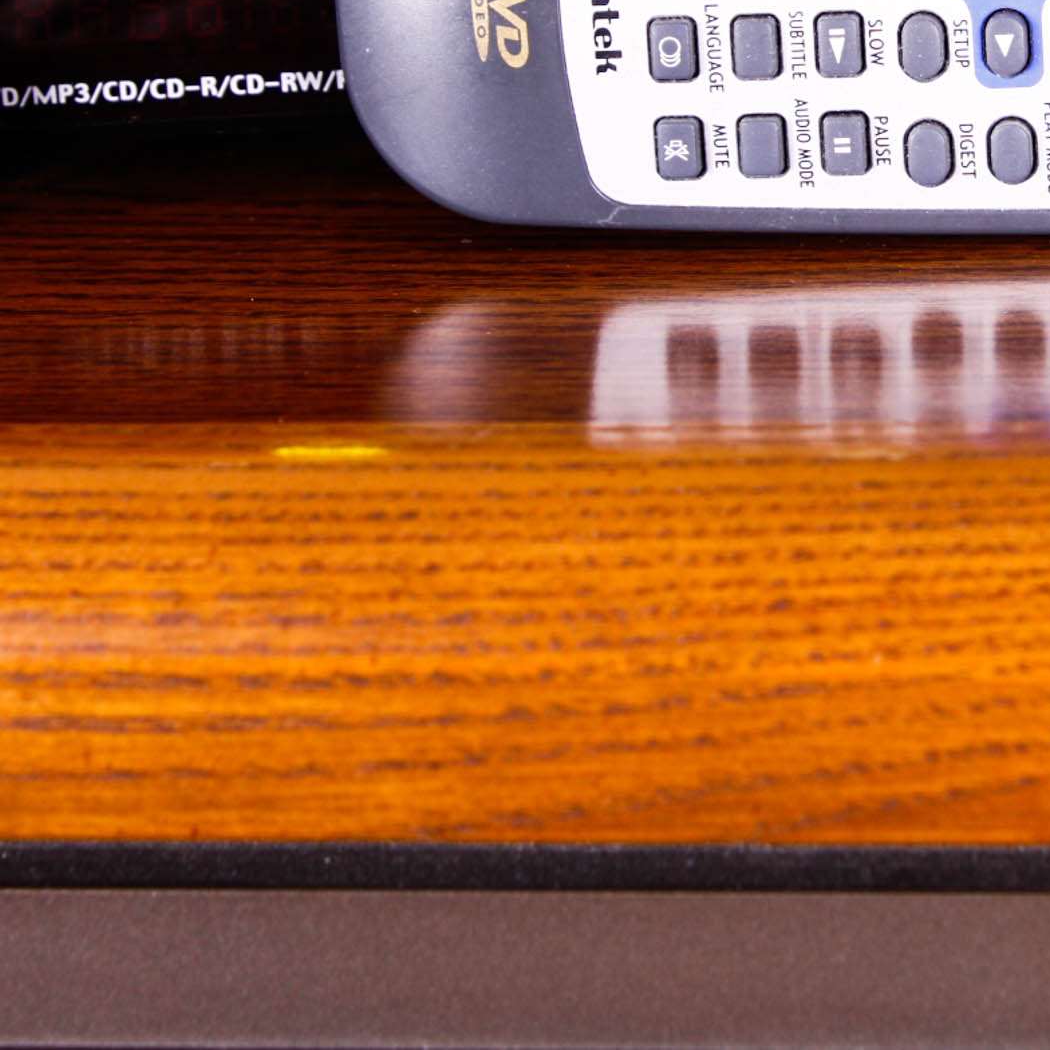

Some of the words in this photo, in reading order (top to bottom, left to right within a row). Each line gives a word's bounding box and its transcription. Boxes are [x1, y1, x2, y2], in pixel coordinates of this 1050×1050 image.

[704, 5, 724, 92] LANGUAGE
[789, 12, 807, 79] SUBTITLE
[868, 20, 884, 65] SLOW
[953, 20, 970, 67] SETUP
[795, 99, 811, 143] AUDIO
[875, 116, 891, 166] PAUSE
[713, 125, 730, 168] MUTE
[798, 149, 814, 187] MODE
[959, 124, 976, 178] DIGEST
